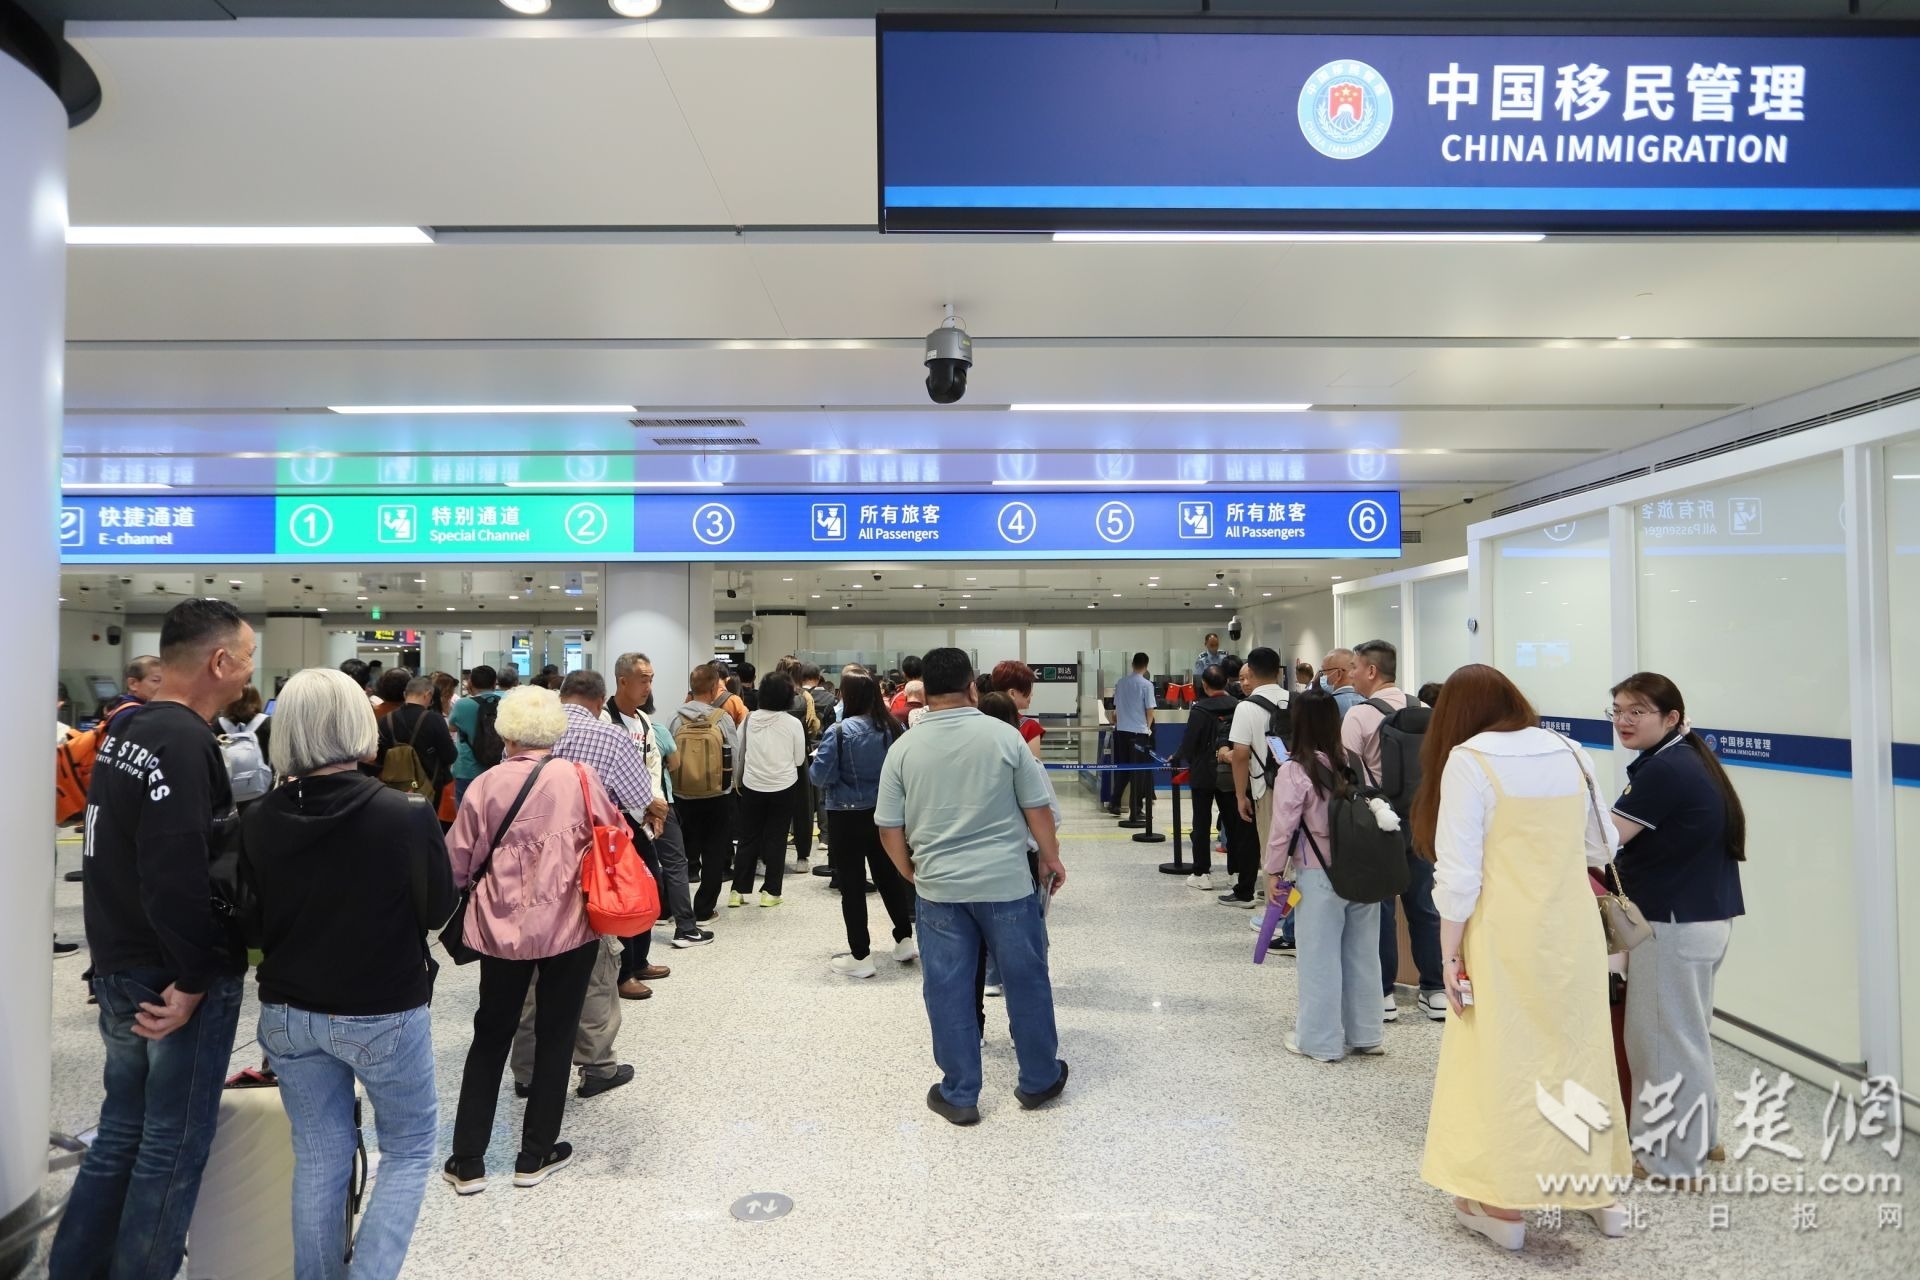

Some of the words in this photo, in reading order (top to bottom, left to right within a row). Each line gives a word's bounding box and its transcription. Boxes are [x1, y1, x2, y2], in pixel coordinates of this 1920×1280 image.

[1428, 62, 1806, 122] 中国移民管理
[1441, 134, 1547, 162] CHINA
[1556, 134, 1788, 163] IMMIGRATION
[98, 506, 195, 527] 快捷通道
[431, 506, 520, 526] 特别通道
[859, 504, 940, 524] 所有旅客
[1226, 503, 1306, 522] 所有旅客
[98, 532, 173, 545] E-channel
[430, 529, 476, 544] Special
[477, 529, 530, 542] Channel
[858, 528, 874, 540] All
[876, 528, 939, 543] Passengers
[1225, 526, 1240, 538] All
[1242, 526, 1305, 541] Passengers
[1057, 667, 1072, 675] 到达
[1720, 735, 1771, 750] 中国移民管理
[1737, 749, 1770, 758] IMMIGRATION
